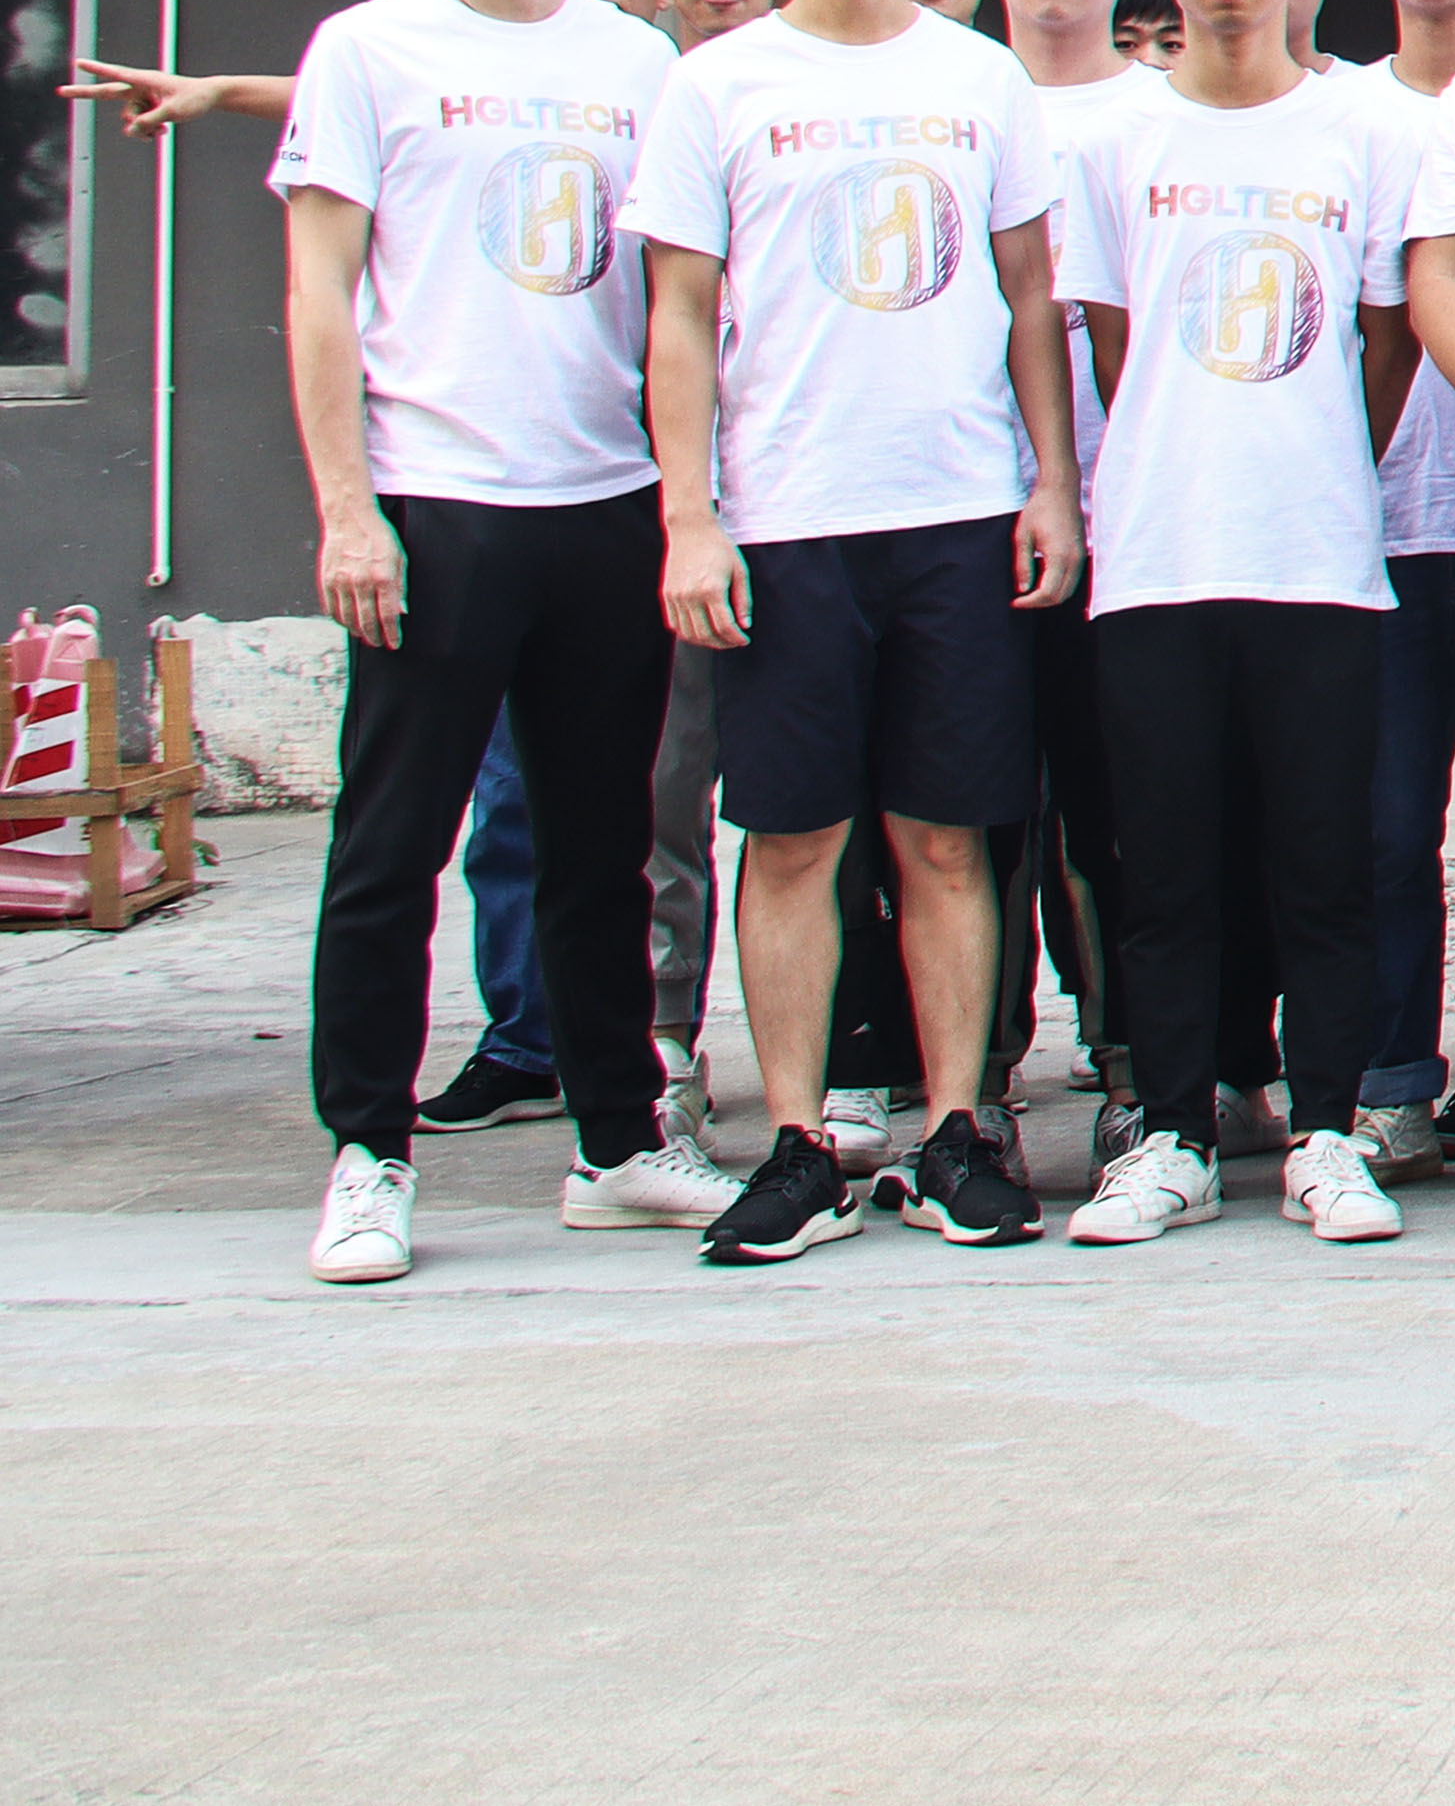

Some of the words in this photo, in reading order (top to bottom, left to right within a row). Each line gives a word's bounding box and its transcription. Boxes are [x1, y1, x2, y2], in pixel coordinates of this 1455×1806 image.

[439, 94, 636, 141] HGLTECH
[769, 114, 978, 158] HGLTECH
[1147, 184, 1350, 233] HGLTECH
